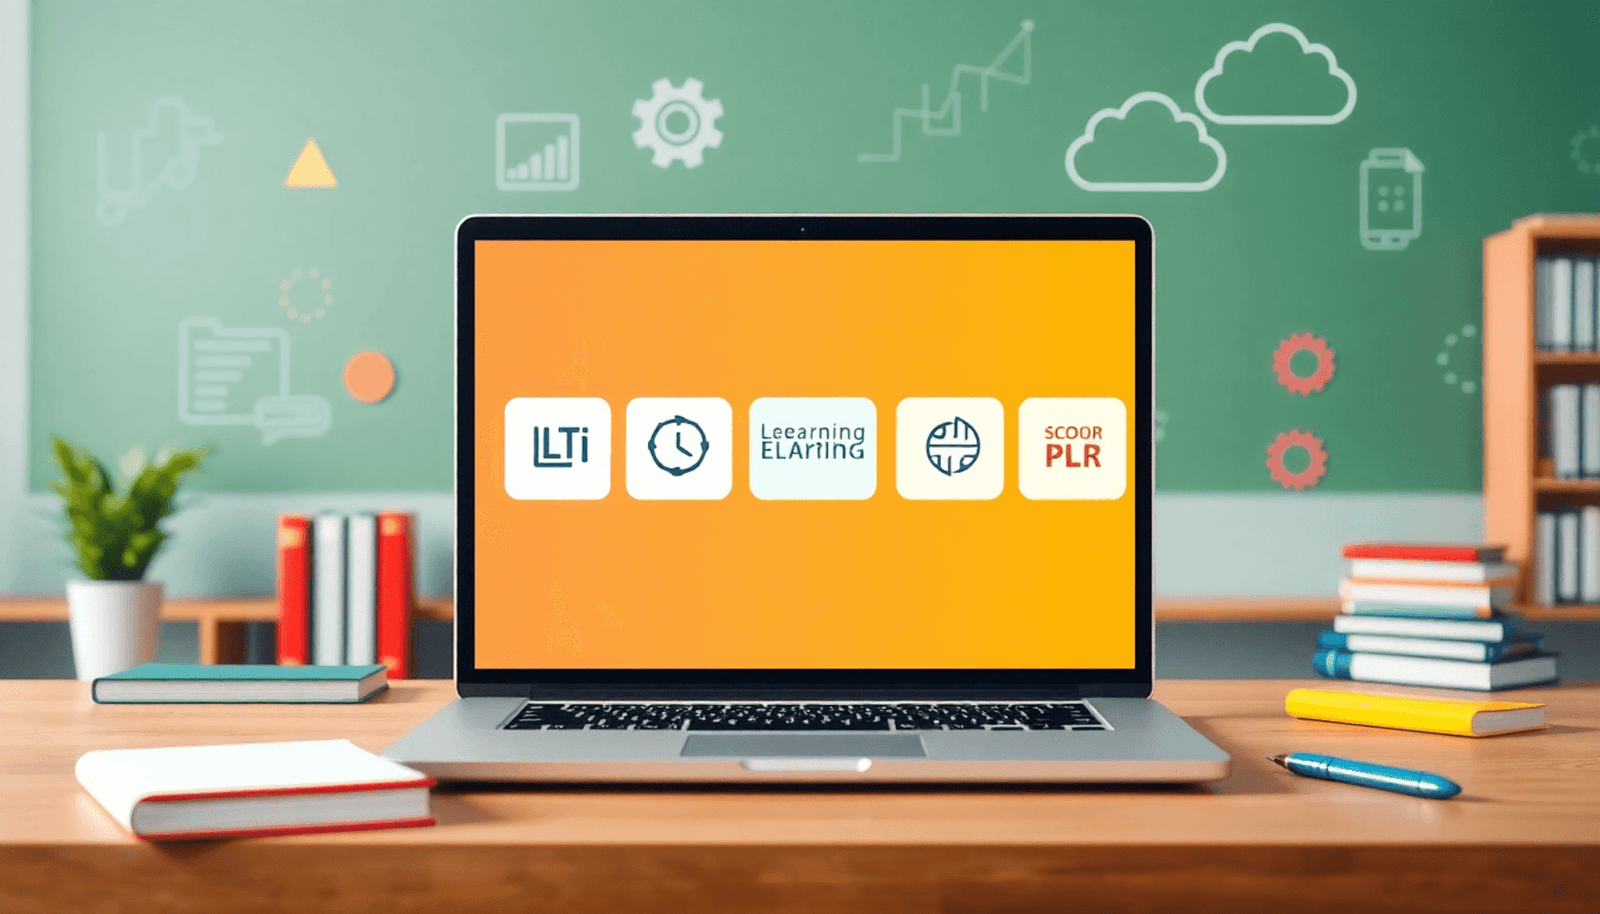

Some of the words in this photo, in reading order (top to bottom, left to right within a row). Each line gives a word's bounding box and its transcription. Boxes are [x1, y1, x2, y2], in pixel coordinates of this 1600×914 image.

[761, 423, 865, 442] Leearning
[1045, 426, 1103, 440] SCOOR
[1046, 444, 1102, 467] PLR
